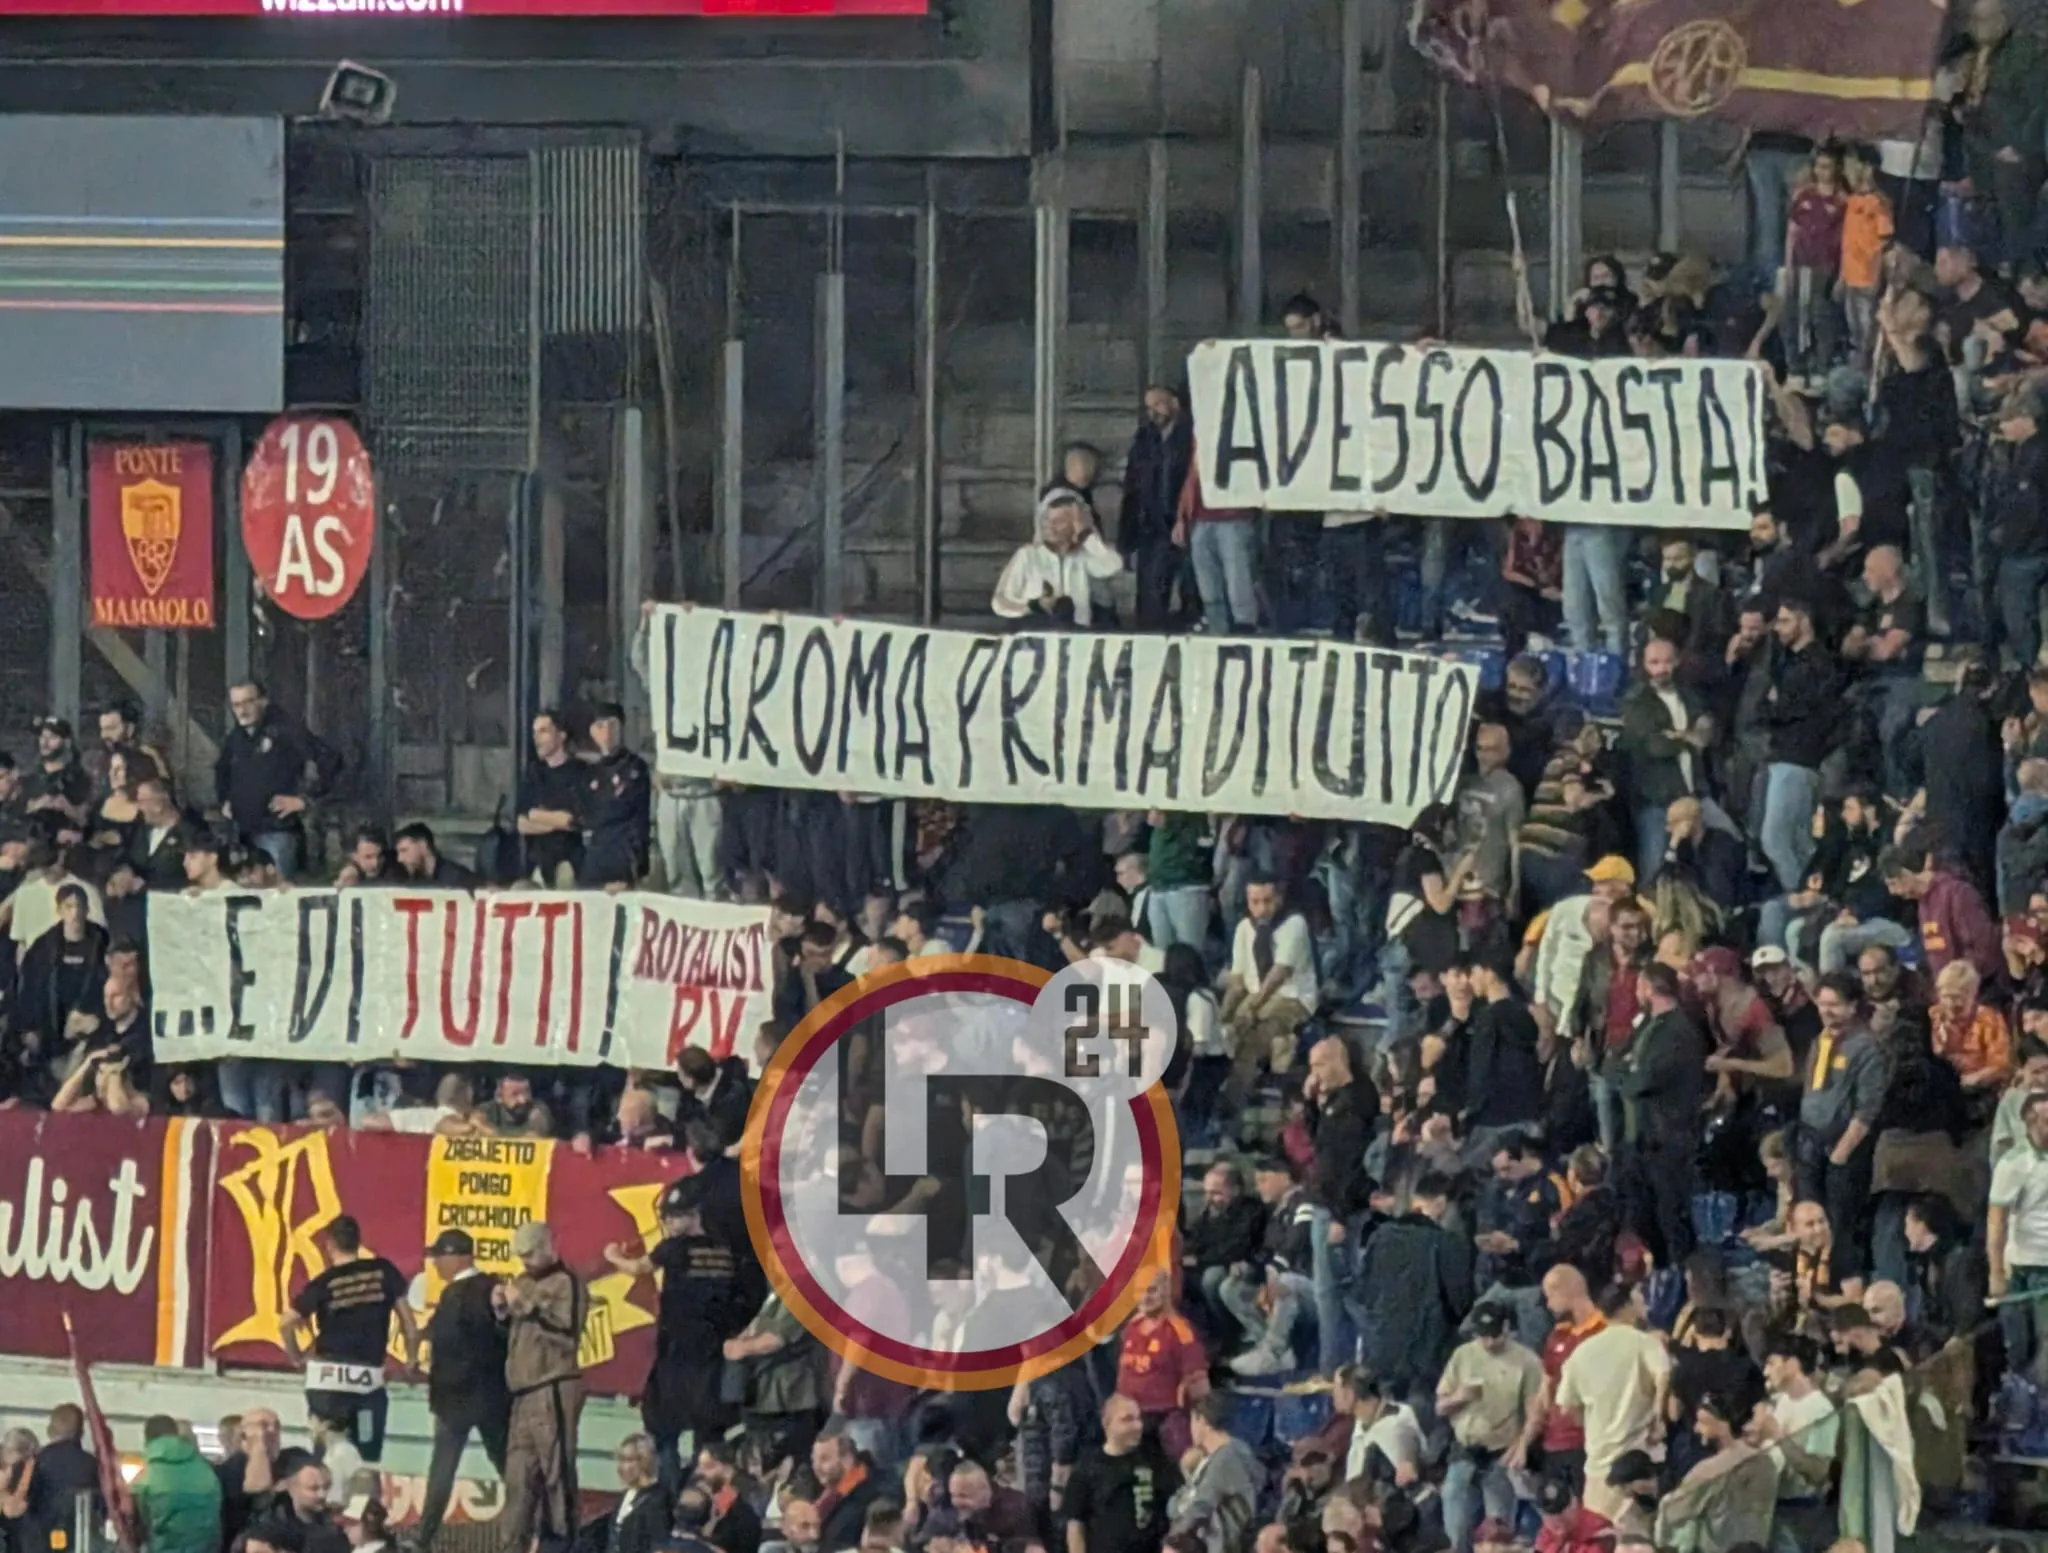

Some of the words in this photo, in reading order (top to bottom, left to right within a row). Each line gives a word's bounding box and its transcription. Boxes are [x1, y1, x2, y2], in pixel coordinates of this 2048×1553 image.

[115, 449, 183, 475] PONTE
[280, 423, 338, 505] 19
[1214, 344, 1503, 500] ADESSO
[1533, 361, 1768, 510] BASTA!
[274, 514, 345, 597] AS
[95, 597, 209, 626] MAMMOLO
[956, 635, 1185, 799] PRIMA
[289, 894, 363, 1044] DI
[633, 906, 765, 993] ROYALIST
[320, 1366, 373, 1386] FILA
